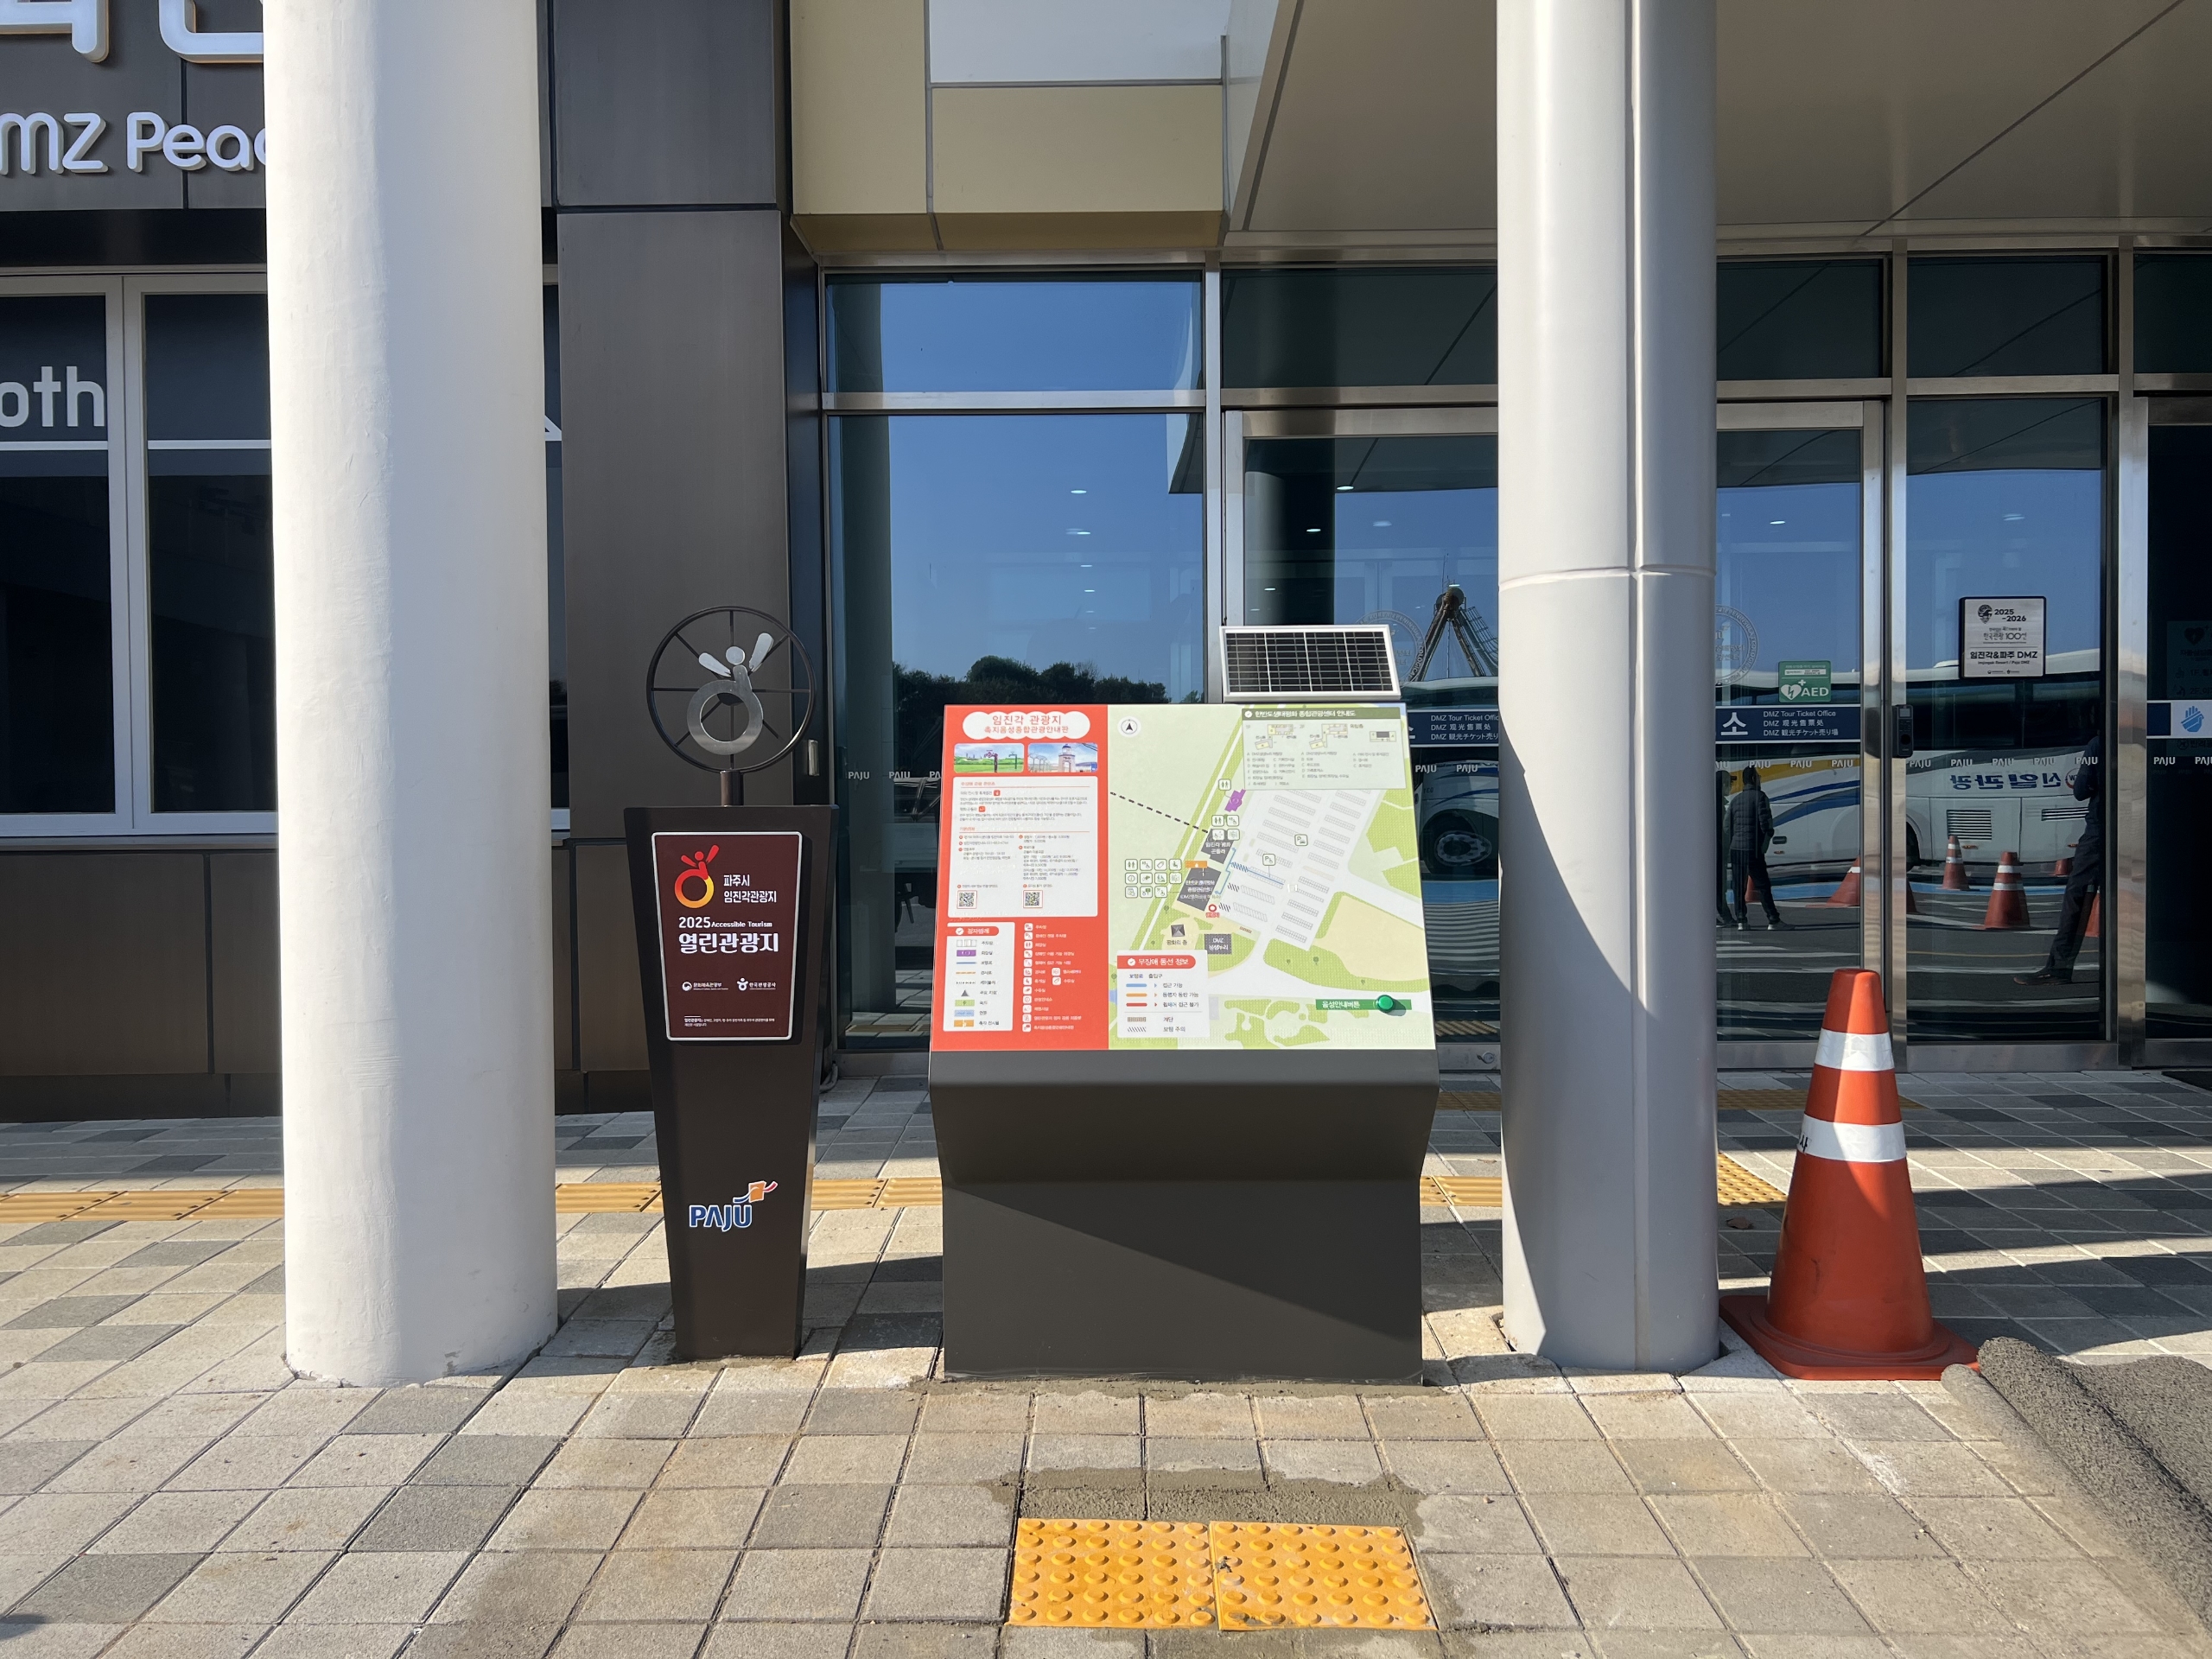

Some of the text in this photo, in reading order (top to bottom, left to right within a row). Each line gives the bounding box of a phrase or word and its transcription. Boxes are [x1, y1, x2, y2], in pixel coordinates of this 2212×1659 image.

[127, 112, 266, 172] Pea
[1970, 651, 2015, 659] 임진각&파주
[1801, 687, 1829, 697] AED
[992, 715, 1062, 726] 임진각 관광지
[1720, 712, 1749, 736] 소
[1749, 760, 1771, 769] PAJU
[1790, 760, 1812, 768] PAJU
[1832, 760, 1853, 768] PAJU
[1910, 757, 2098, 768] PAJU PAJU PAJU PAJU PAJU
[2153, 756, 2176, 766] PAJU
[1415, 765, 1478, 774] PAJU PAJU
[848, 772, 870, 780] PAJU
[723, 874, 750, 887] 파주시
[724, 890, 777, 904] 임진각관광지
[678, 917, 710, 929] 2025
[679, 932, 779, 954] 열린관광지
[690, 1205, 753, 1232] PAJU
